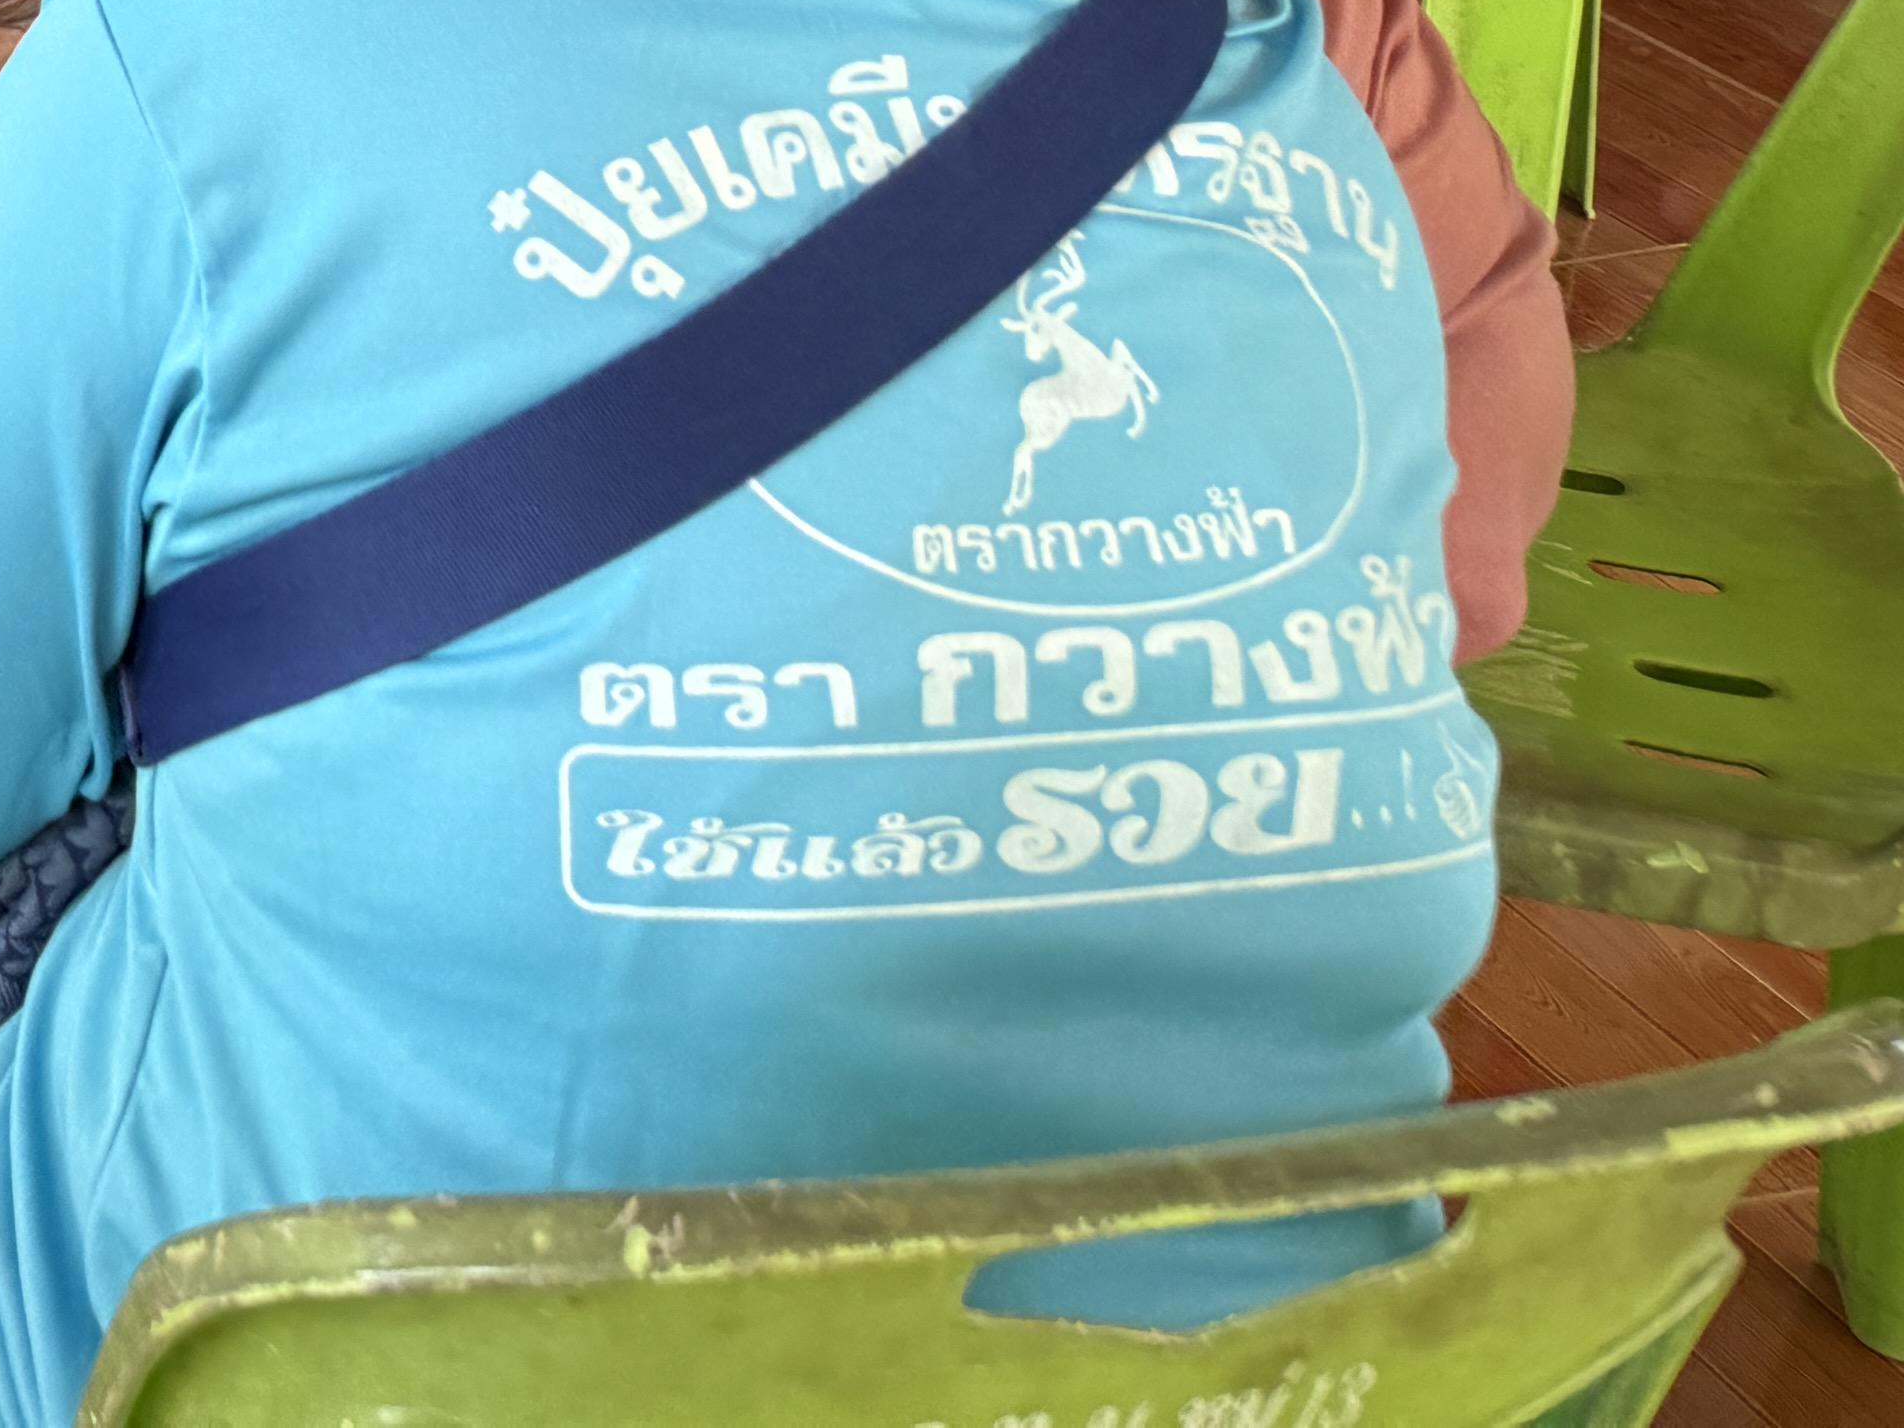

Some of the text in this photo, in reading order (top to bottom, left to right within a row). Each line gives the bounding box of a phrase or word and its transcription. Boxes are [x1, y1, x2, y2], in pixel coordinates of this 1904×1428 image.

[912, 485, 1297, 573] ตรากวางฟ้า
[578, 553, 1457, 732] ตรา กวางฟ้า
